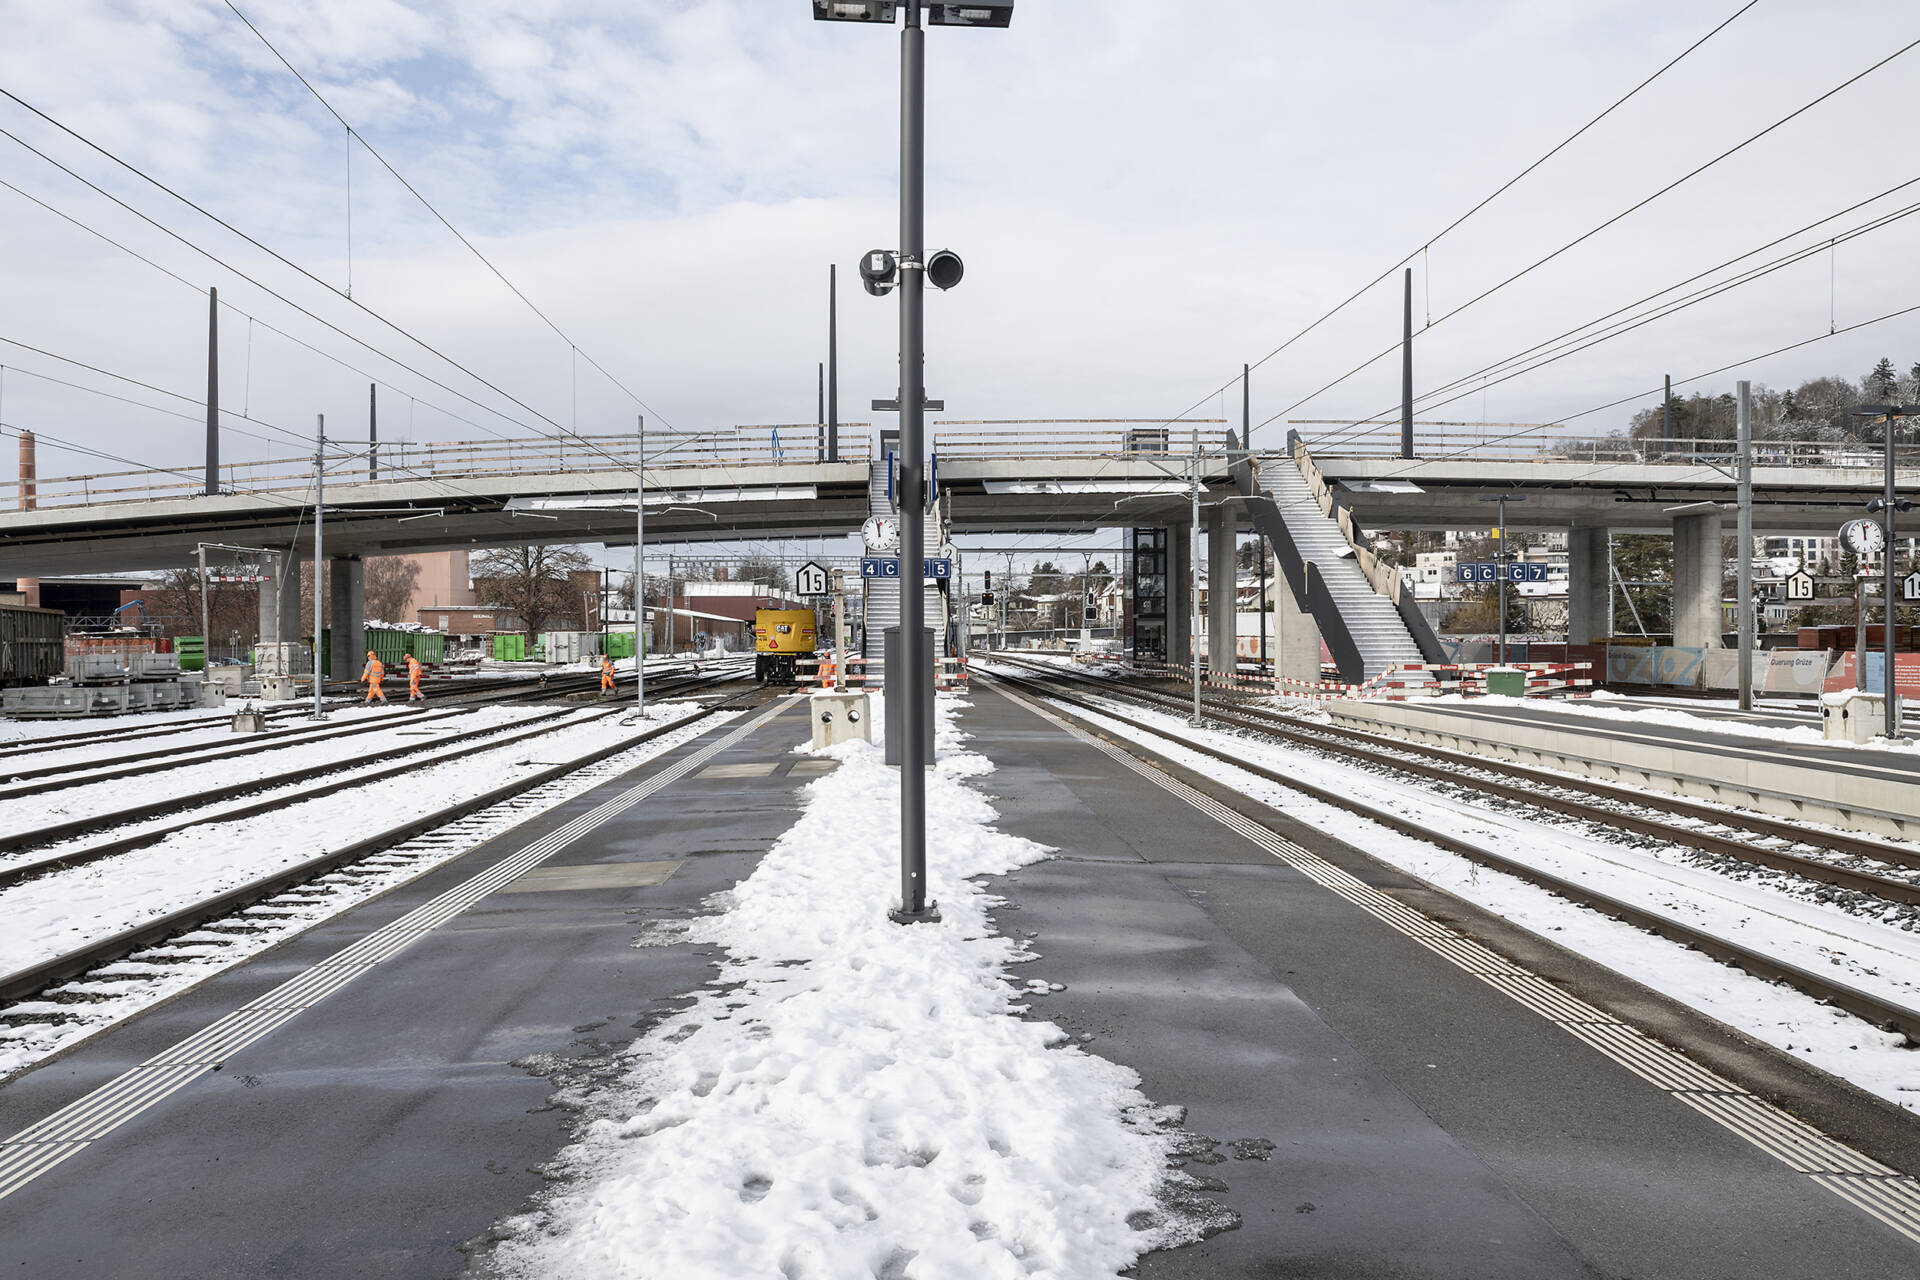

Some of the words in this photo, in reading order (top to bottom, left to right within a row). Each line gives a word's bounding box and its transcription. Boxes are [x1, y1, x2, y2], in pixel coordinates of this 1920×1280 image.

[866, 565, 874, 574] 4
[886, 565, 894, 574] C
[937, 565, 945, 574] 5
[1463, 569, 1472, 579] 6
[1483, 569, 1492, 579] C
[1514, 569, 1522, 579] C
[1534, 569, 1541, 579] 7
[803, 570, 821, 591] 15
[1792, 577, 1809, 597] 15
[776, 625, 788, 633] CAT
[1770, 658, 1794, 667] Querung
[1795, 658, 1812, 666] Grüze
